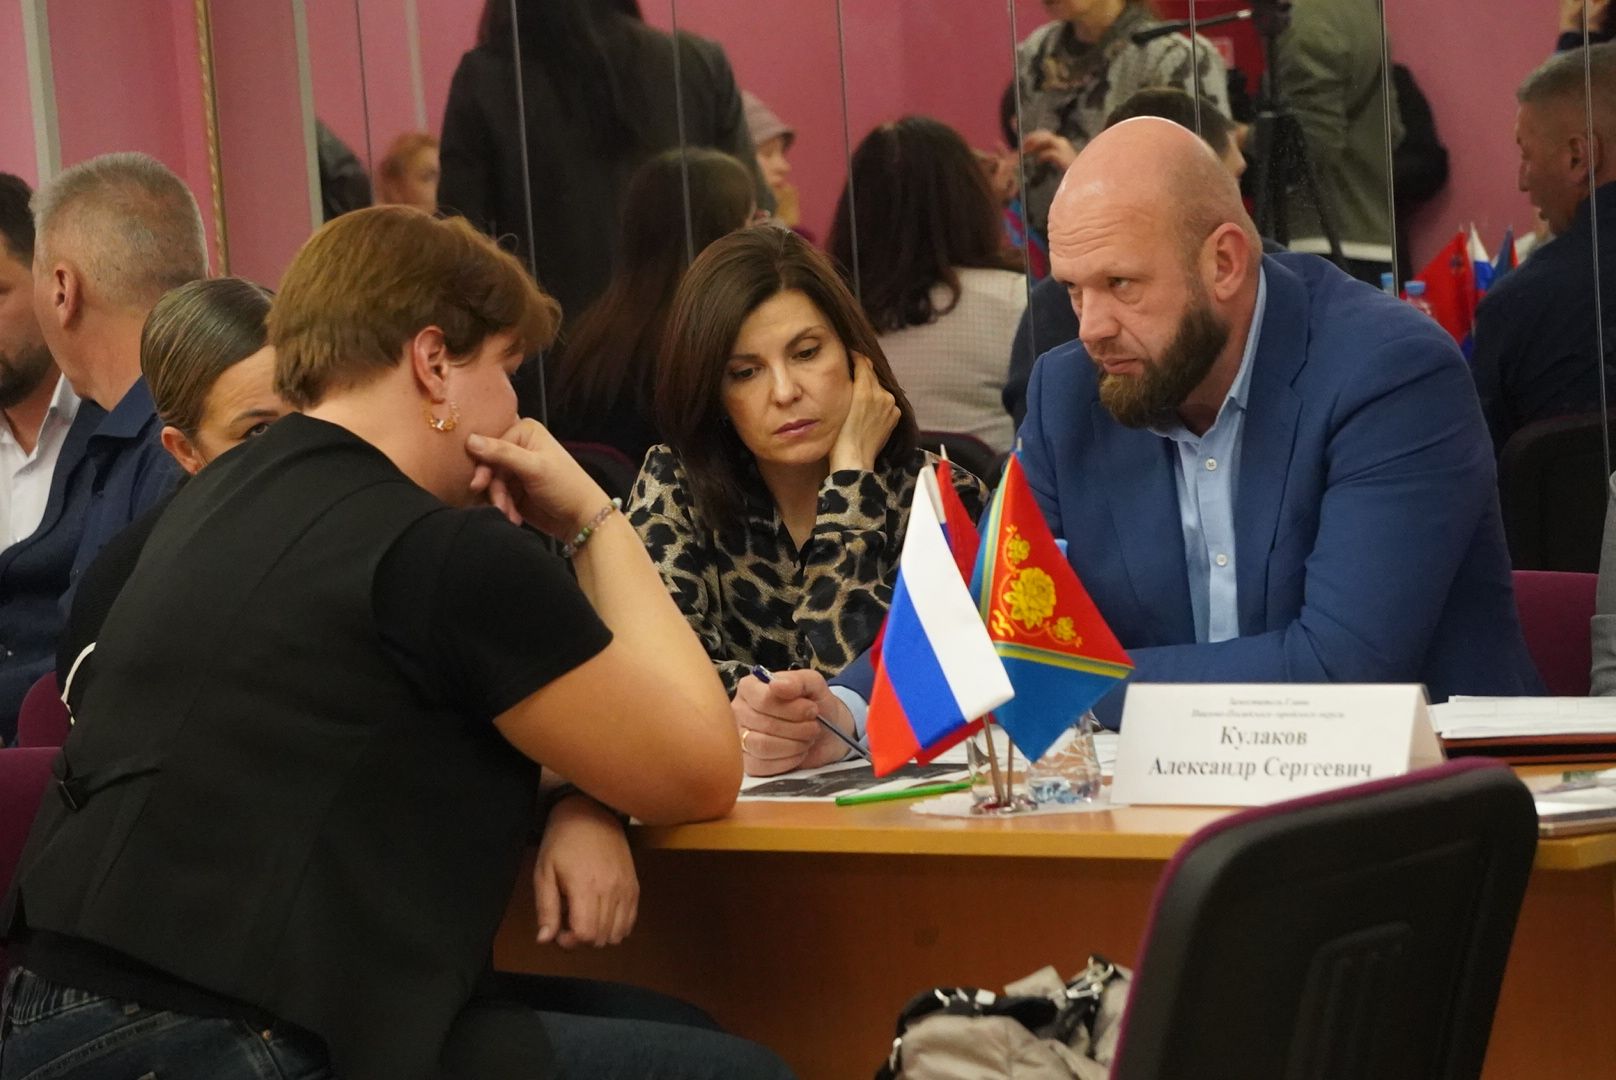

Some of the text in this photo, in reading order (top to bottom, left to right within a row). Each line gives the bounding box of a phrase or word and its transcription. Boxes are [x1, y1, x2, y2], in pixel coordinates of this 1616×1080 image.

[1220, 725, 1308, 750] Кулаков
[1148, 757, 1373, 781] Александр Сергеевич
